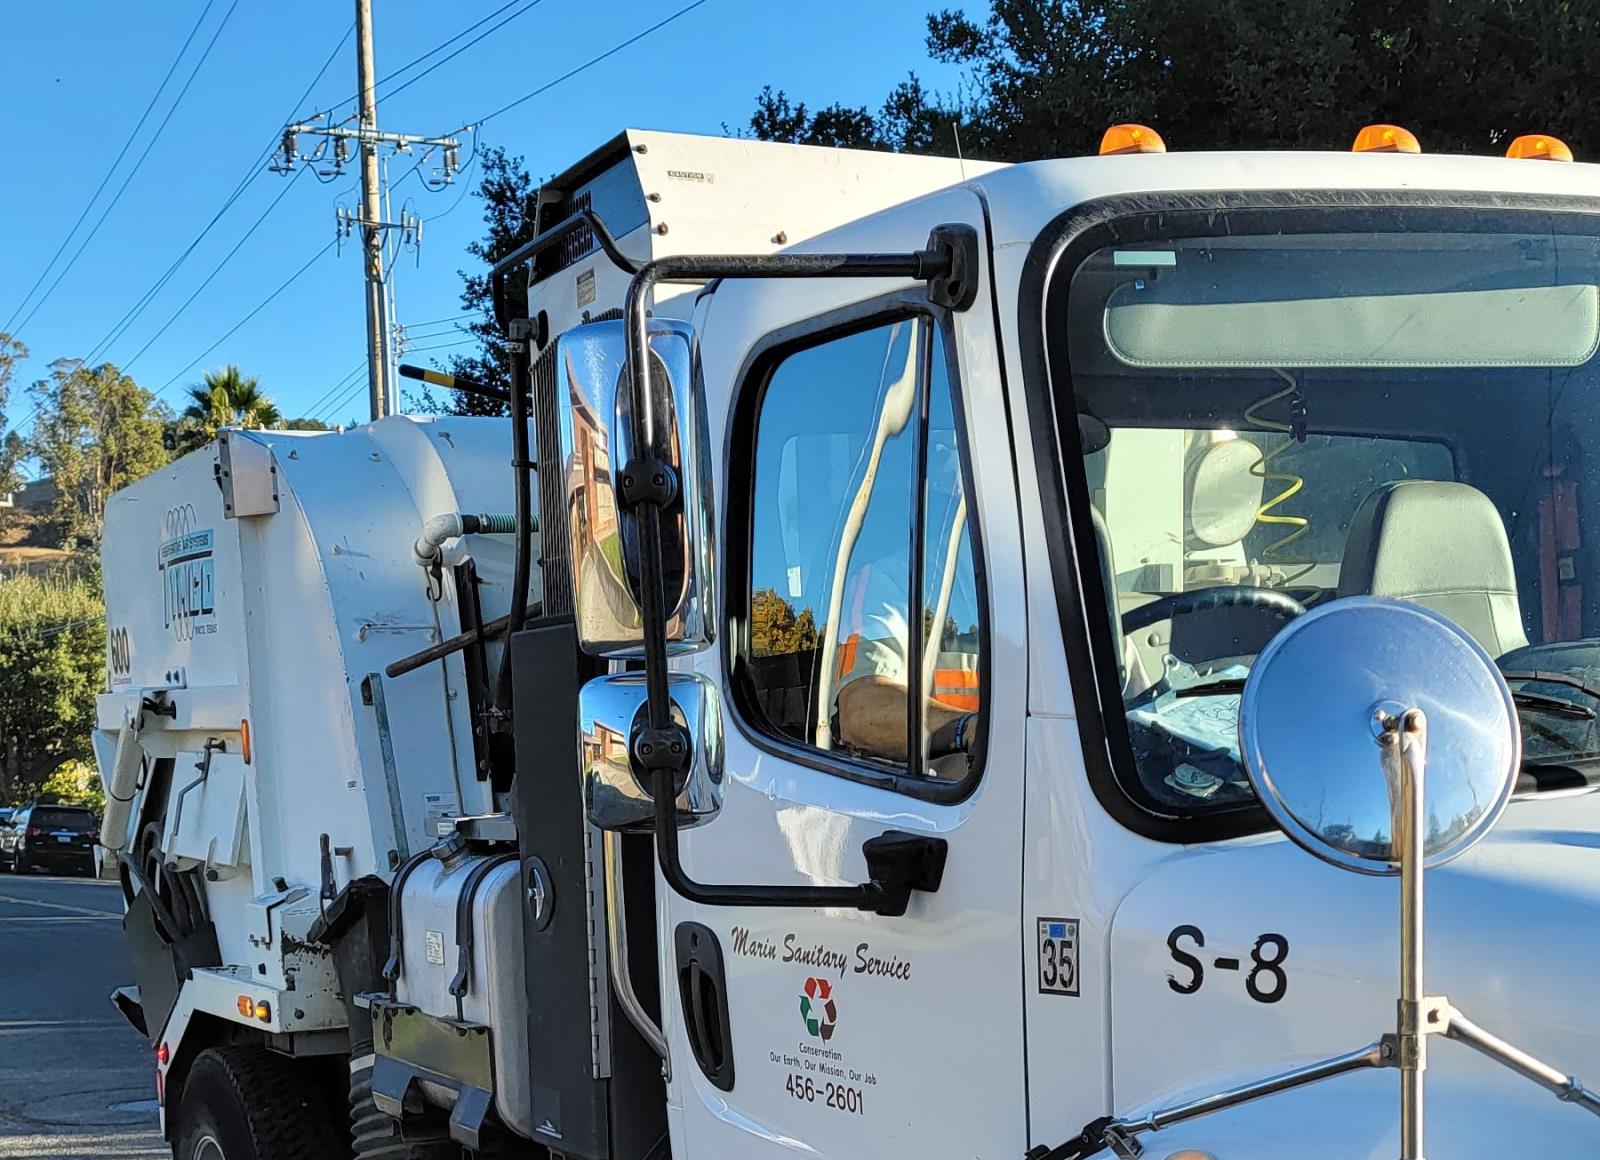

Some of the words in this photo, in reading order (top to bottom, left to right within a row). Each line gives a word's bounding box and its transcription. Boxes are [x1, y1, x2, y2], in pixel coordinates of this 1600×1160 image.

[110, 626, 130, 674] 600
[731, 926, 777, 961] Marin
[782, 933, 848, 979] Sanitary
[854, 943, 911, 981] Service
[1043, 938, 1074, 988] 35
[1166, 924, 1289, 1004] S-8
[769, 1051, 781, 1063] Our
[783, 1054, 803, 1070] Earth,
[804, 1059, 817, 1071] Our
[819, 1063, 847, 1080] Mission,
[849, 1069, 862, 1082] Our
[864, 1073, 877, 1085] Job
[799, 1042, 842, 1061] Conservation
[785, 1073, 864, 1115] 456-2601
